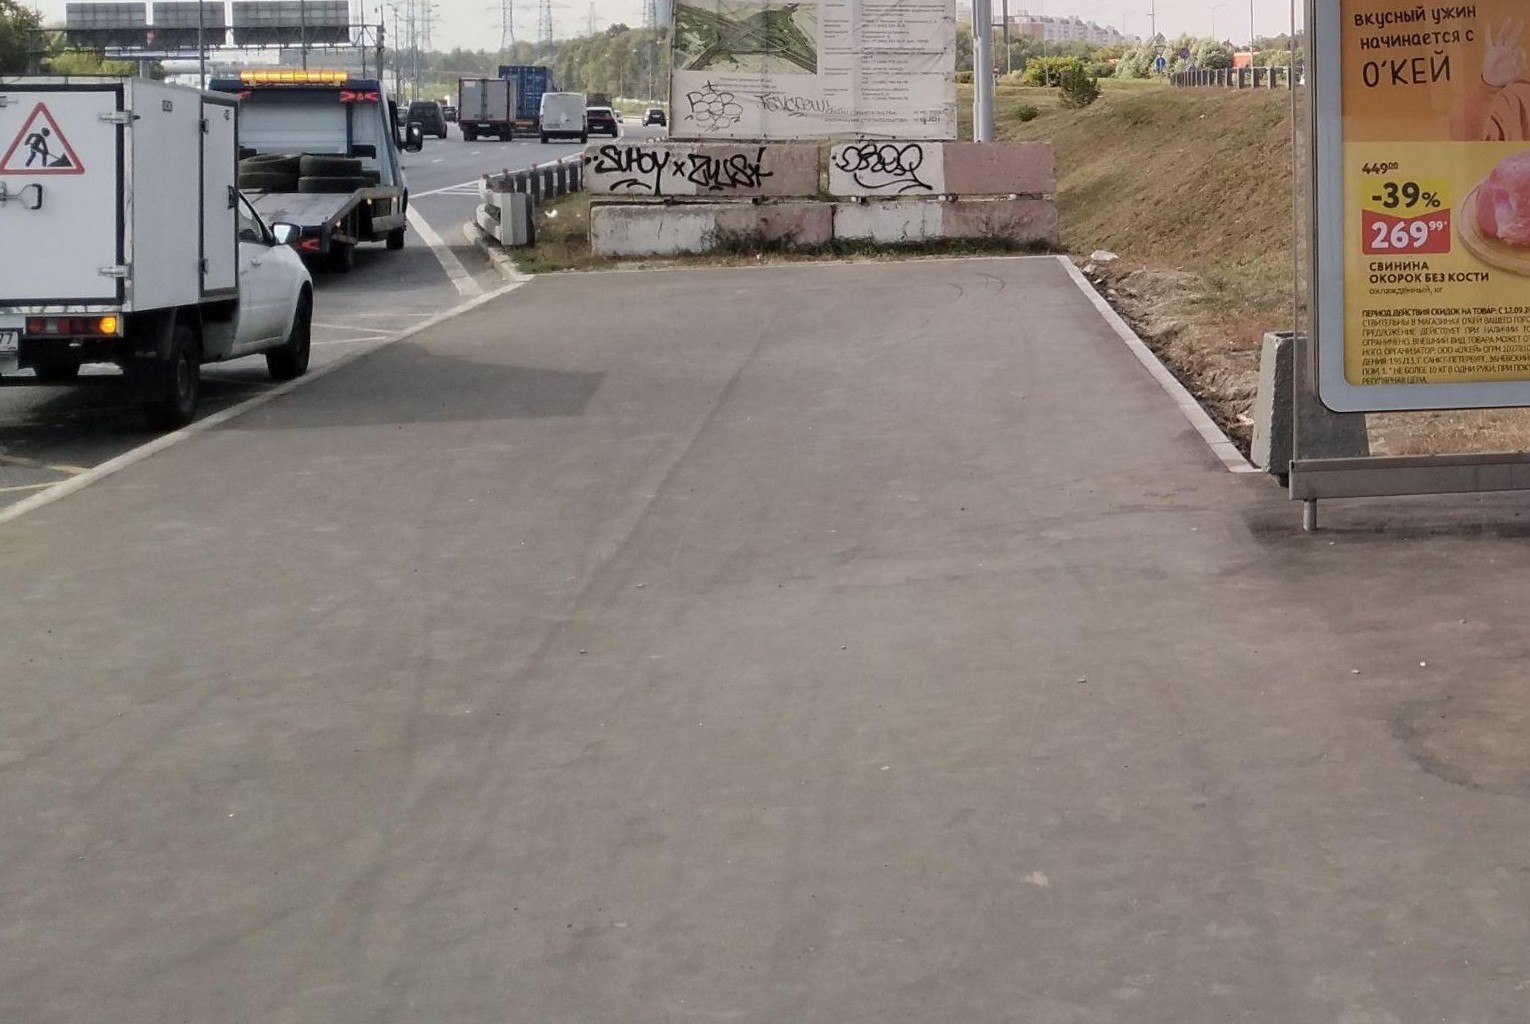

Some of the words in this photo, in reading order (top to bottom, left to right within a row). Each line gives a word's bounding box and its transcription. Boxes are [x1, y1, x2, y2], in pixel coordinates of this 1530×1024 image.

[1354, 5, 1426, 29] вкусный
[1431, 5, 1477, 25] ужин
[1360, 28, 1461, 51] начинается
[1362, 49, 1451, 88] О'КЕЙ
[1372, 182, 1441, 208] -39%
[1369, 262, 1430, 272] СВИНИНА
[1369, 273, 1422, 284] ОКОРОК
[1425, 273, 1445, 283] БЕЗ
[1448, 272, 1489, 282] КОСТИ
